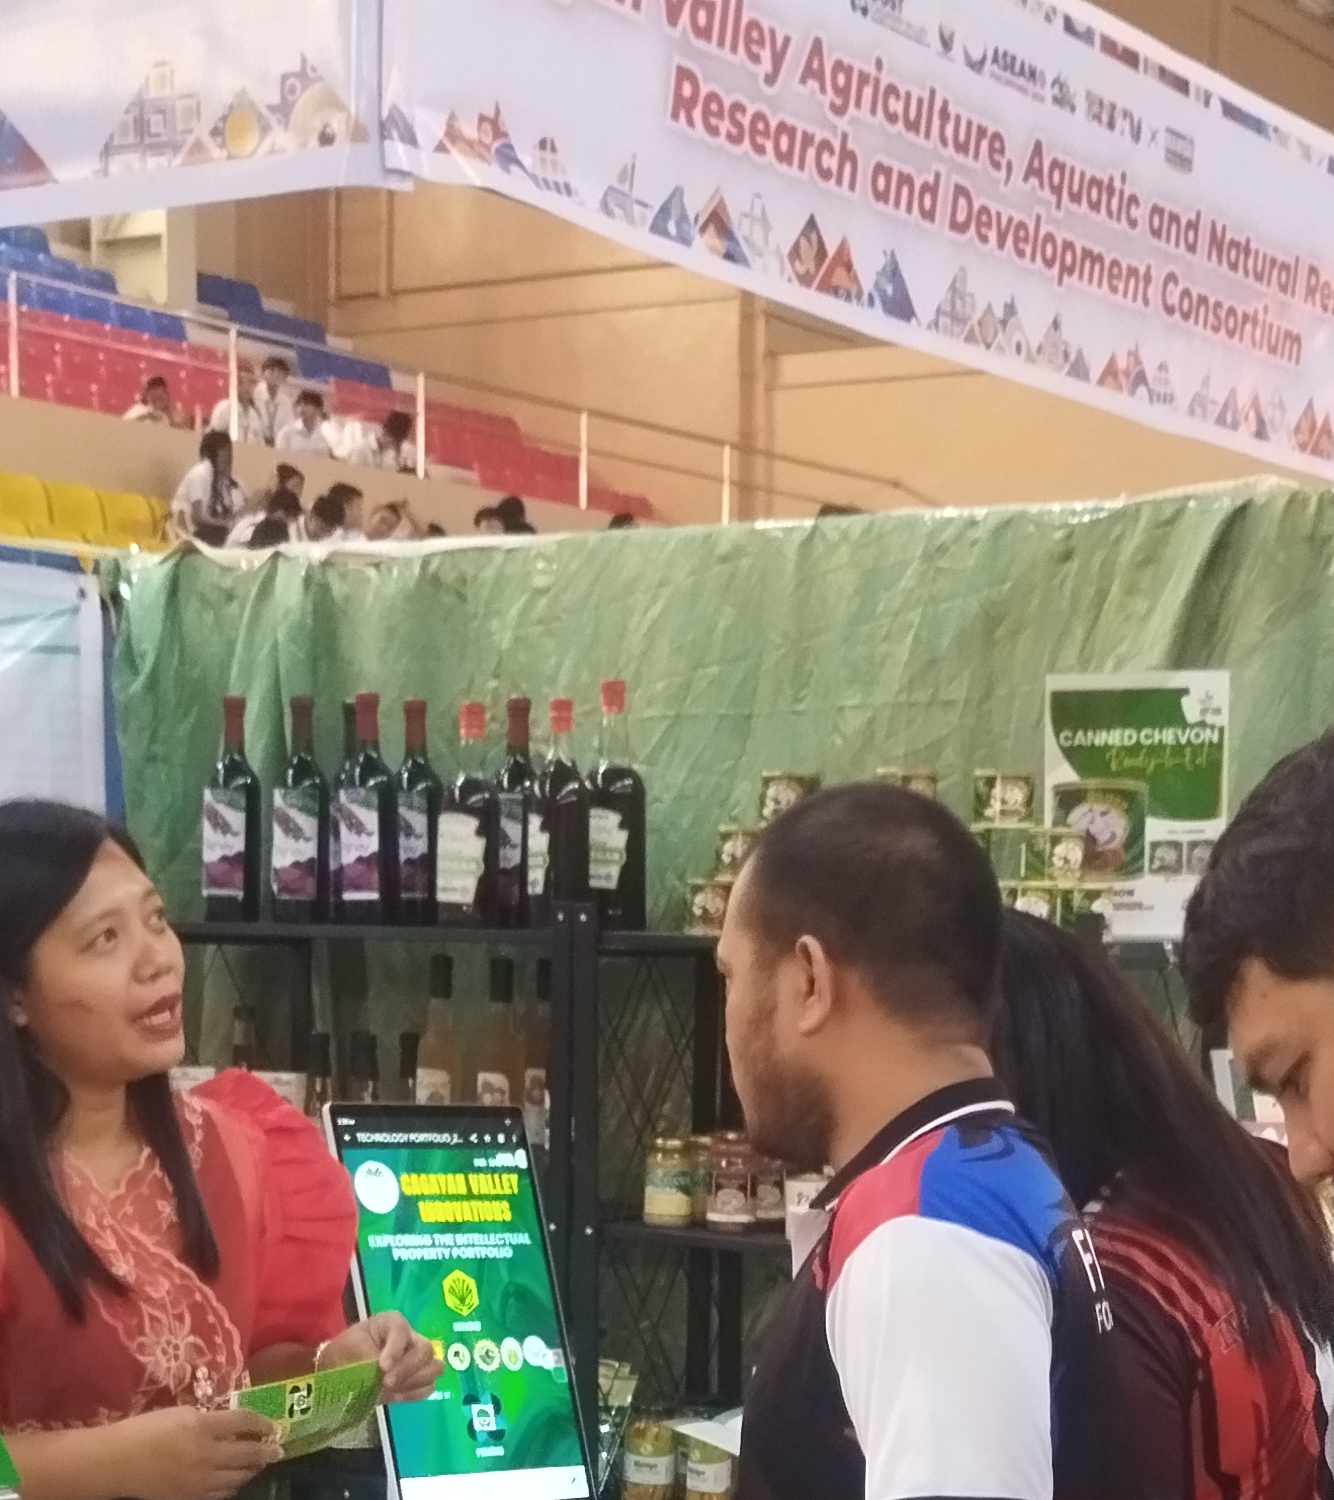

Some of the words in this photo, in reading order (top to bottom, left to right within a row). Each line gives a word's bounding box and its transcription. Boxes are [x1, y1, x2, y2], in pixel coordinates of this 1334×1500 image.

[670, 63, 860, 194] Research
[870, 159, 942, 225] and
[948, 183, 1153, 308] Development
[1161, 271, 1303, 367] Consortium
[798, 36, 1014, 186] Agriculture,
[1022, 139, 1141, 231] Aquatic
[1147, 210, 1202, 257] and
[1207, 219, 1300, 298] Natural
[1058, 728, 1138, 747] CANNED
[1139, 726, 1219, 746] CHEVON
[467, 1172, 519, 1195] VALLEY
